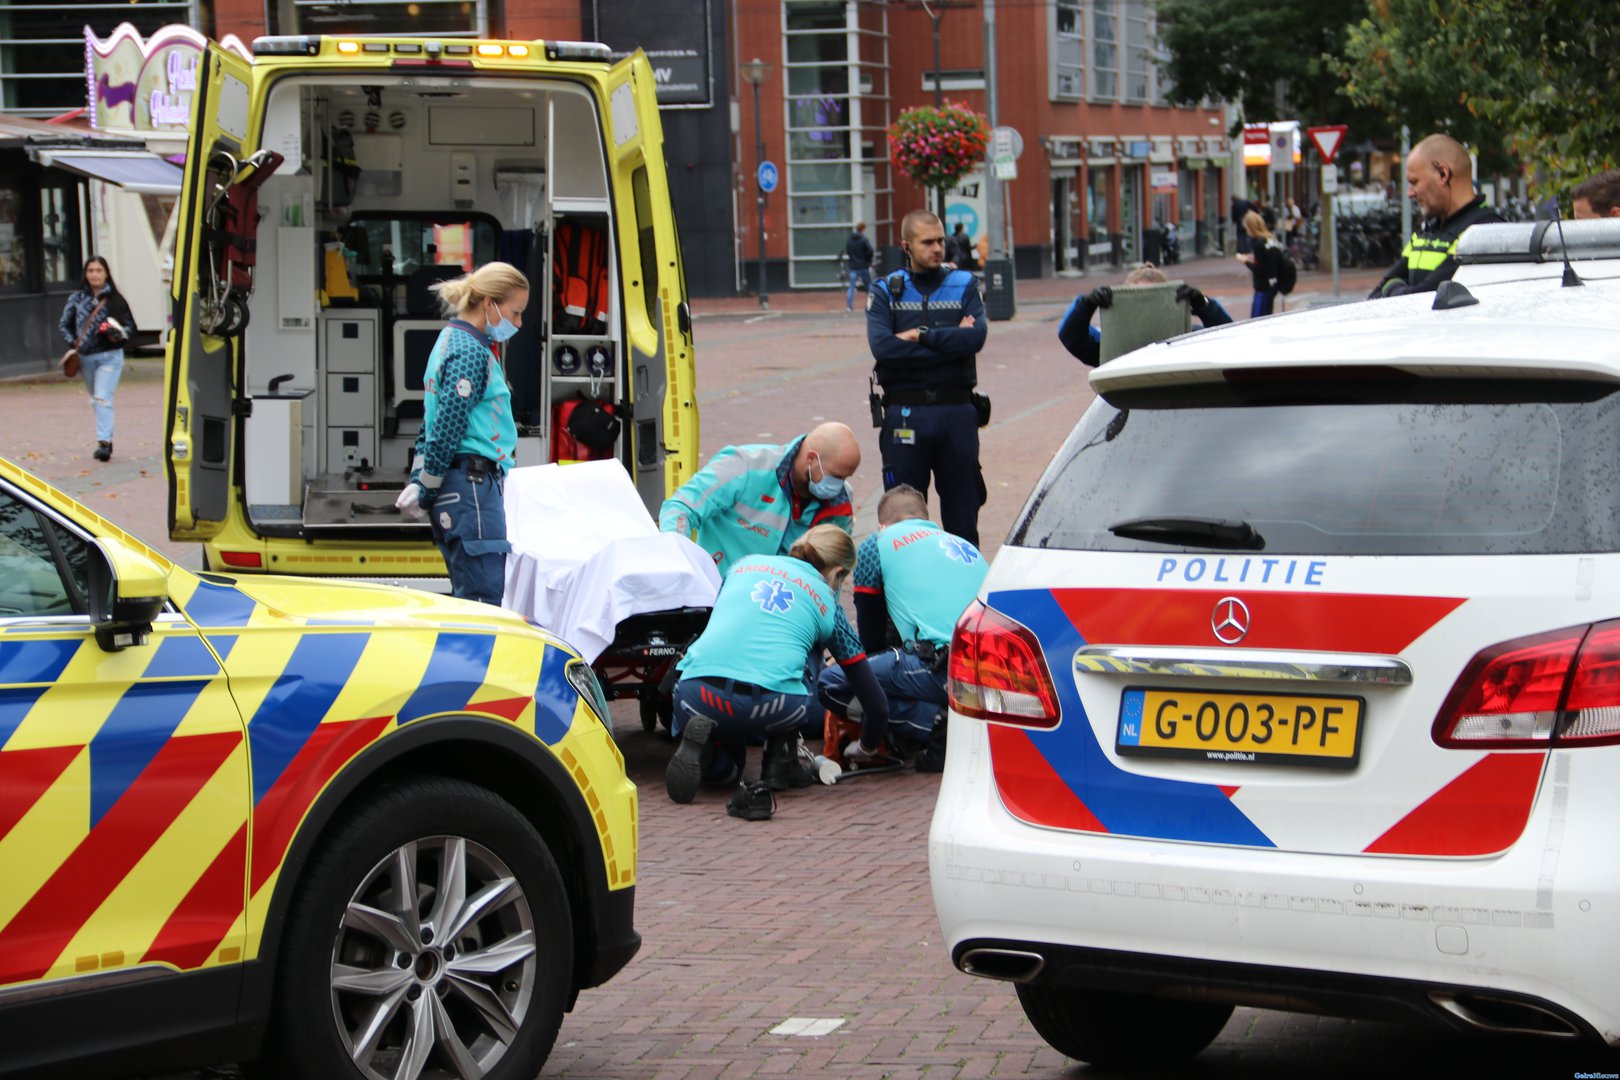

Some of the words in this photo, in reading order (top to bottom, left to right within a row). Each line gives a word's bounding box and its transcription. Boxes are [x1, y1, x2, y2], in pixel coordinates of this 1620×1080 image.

[1157, 558, 1328, 586] POLITIE
[735, 564, 828, 617] AMBULANCE
[649, 647, 676, 656] FERNO
[1122, 723, 1138, 737] NL
[1155, 699, 1344, 747] G-003-PF
[1206, 751, 1255, 762] www.politie.nl
